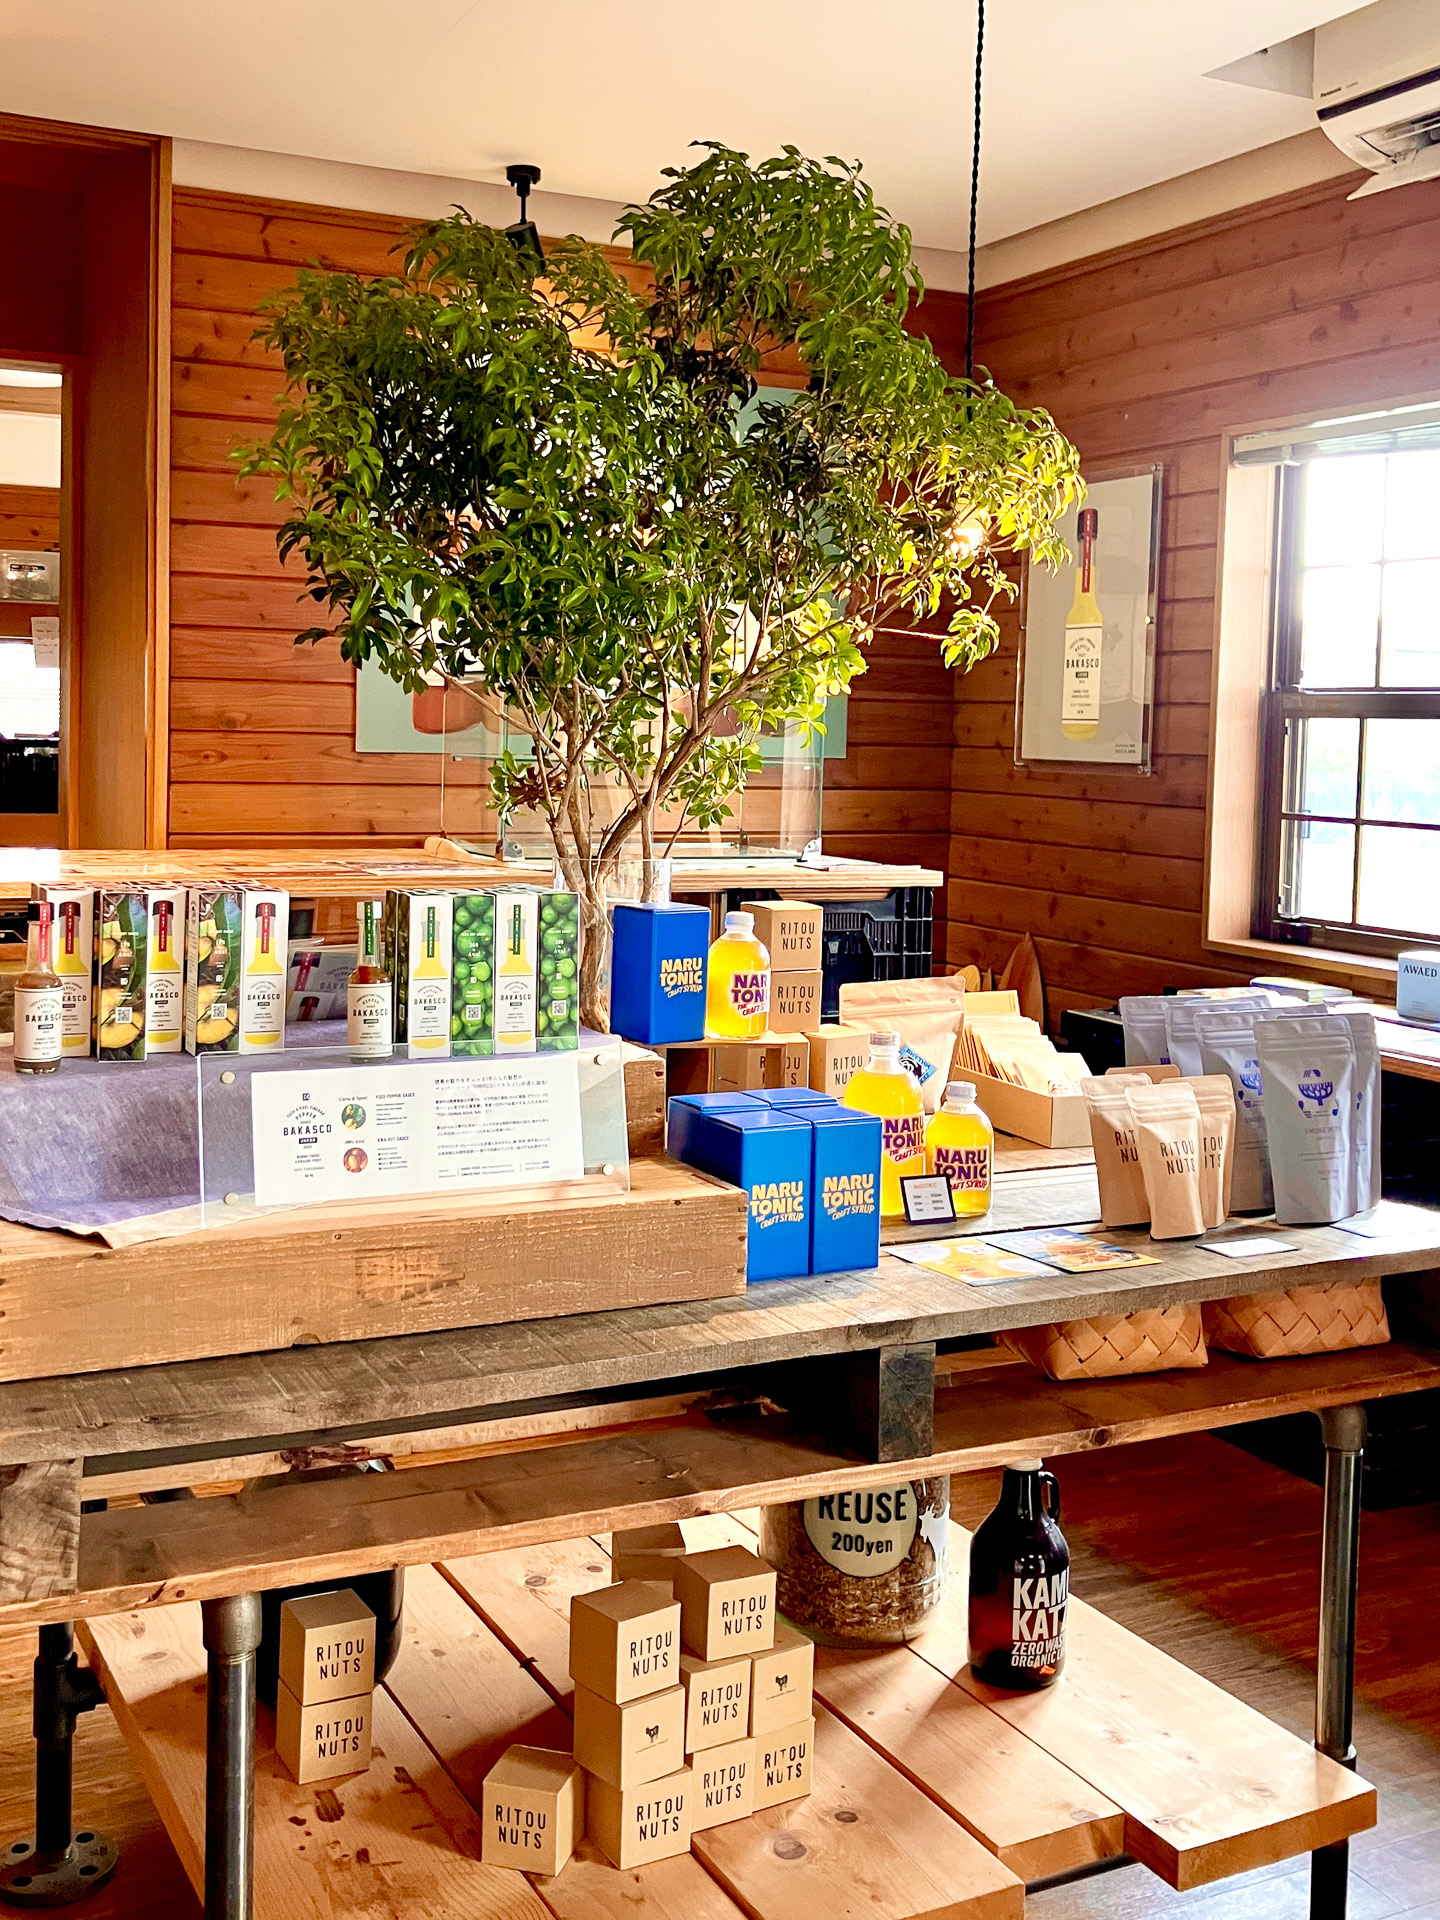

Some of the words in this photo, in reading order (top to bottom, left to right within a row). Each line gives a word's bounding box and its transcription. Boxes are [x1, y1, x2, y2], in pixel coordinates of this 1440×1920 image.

[1066, 658, 1099, 669] BAKASCO
[781, 922, 815, 935] RITOU
[782, 937, 812, 950] NUTS
[661, 957, 703, 973] NARU
[1403, 964, 1438, 978] AWAED
[320, 982, 345, 990] BAKA
[660, 970, 703, 987] TONIC
[734, 974, 768, 989] NAR
[149, 991, 179, 999] AKASCO
[247, 993, 280, 1001] BAKASCO
[500, 993, 532, 1001] BAKASCO
[667, 986, 683, 999] CRAFT
[683, 984, 704, 993] SYRUP
[731, 988, 768, 1004] TONI
[778, 985, 815, 999] RITOU
[414, 997, 447, 1005] BAKASCO
[737, 1003, 747, 1011] THE
[743, 1005, 760, 1016] CRAFT
[780, 1001, 811, 1014] NUTS
[353, 1008, 389, 1017] BAKASCO
[760, 1056, 801, 1070] ROU
[833, 1055, 863, 1070] RITOU
[835, 1071, 853, 1085] NUT
[283, 1123, 332, 1136] BAKASCO
[885, 1114, 924, 1134] NARU
[883, 1131, 924, 1149] TONIC
[1114, 1129, 1136, 1146] RIT
[1203, 1136, 1223, 1153] TOU
[889, 1149, 900, 1157] THE
[895, 1150, 913, 1162] CRAFT
[936, 1148, 988, 1165] NARU
[1120, 1147, 1139, 1164] NU
[1160, 1139, 1195, 1157] RITOU
[1166, 1158, 1195, 1175] NUTS
[1204, 1153, 1221, 1169] TS
[934, 1163, 988, 1180] TONIC
[752, 1180, 804, 1200] NARU
[823, 1173, 874, 1192] NARU
[951, 1182, 965, 1191] AFT
[965, 1179, 988, 1189] SYRUP
[750, 1196, 804, 1216] TONIC
[822, 1188, 875, 1208] TONIC
[755, 1214, 765, 1224] THE
[760, 1215, 779, 1229] CRAFT
[779, 1212, 805, 1222] SYRUP
[832, 1207, 851, 1221] CRAFT
[851, 1204, 875, 1215] SYRUP
[818, 1489, 908, 1524] REUSE
[831, 1532, 893, 1557] 200yen
[722, 1594, 767, 1618] RITOU
[724, 1615, 763, 1636] NUTS
[316, 1638, 365, 1663] RITOU
[630, 1630, 672, 1659] RITOU
[1011, 1640, 1045, 1656] ZERO
[1045, 1634, 1063, 1654] WAS
[633, 1652, 669, 1678] NUTS
[1011, 1649, 1057, 1668] ORGANIC
[320, 1658, 361, 1680] NUTS
[701, 1682, 743, 1708] RITOU
[703, 1702, 739, 1727] NUTS
[315, 1716, 364, 1741] RITOU
[318, 1736, 359, 1758] NUTS
[764, 1742, 806, 1770] RITOU
[703, 1762, 746, 1789] RITOU
[766, 1763, 803, 1787] NUTS
[705, 1783, 742, 1808] NUTS
[495, 1804, 548, 1830] RITOU
[636, 1795, 684, 1822] RITOU
[498, 1825, 542, 1850] NUTS
[638, 1817, 680, 1842] NUTS
